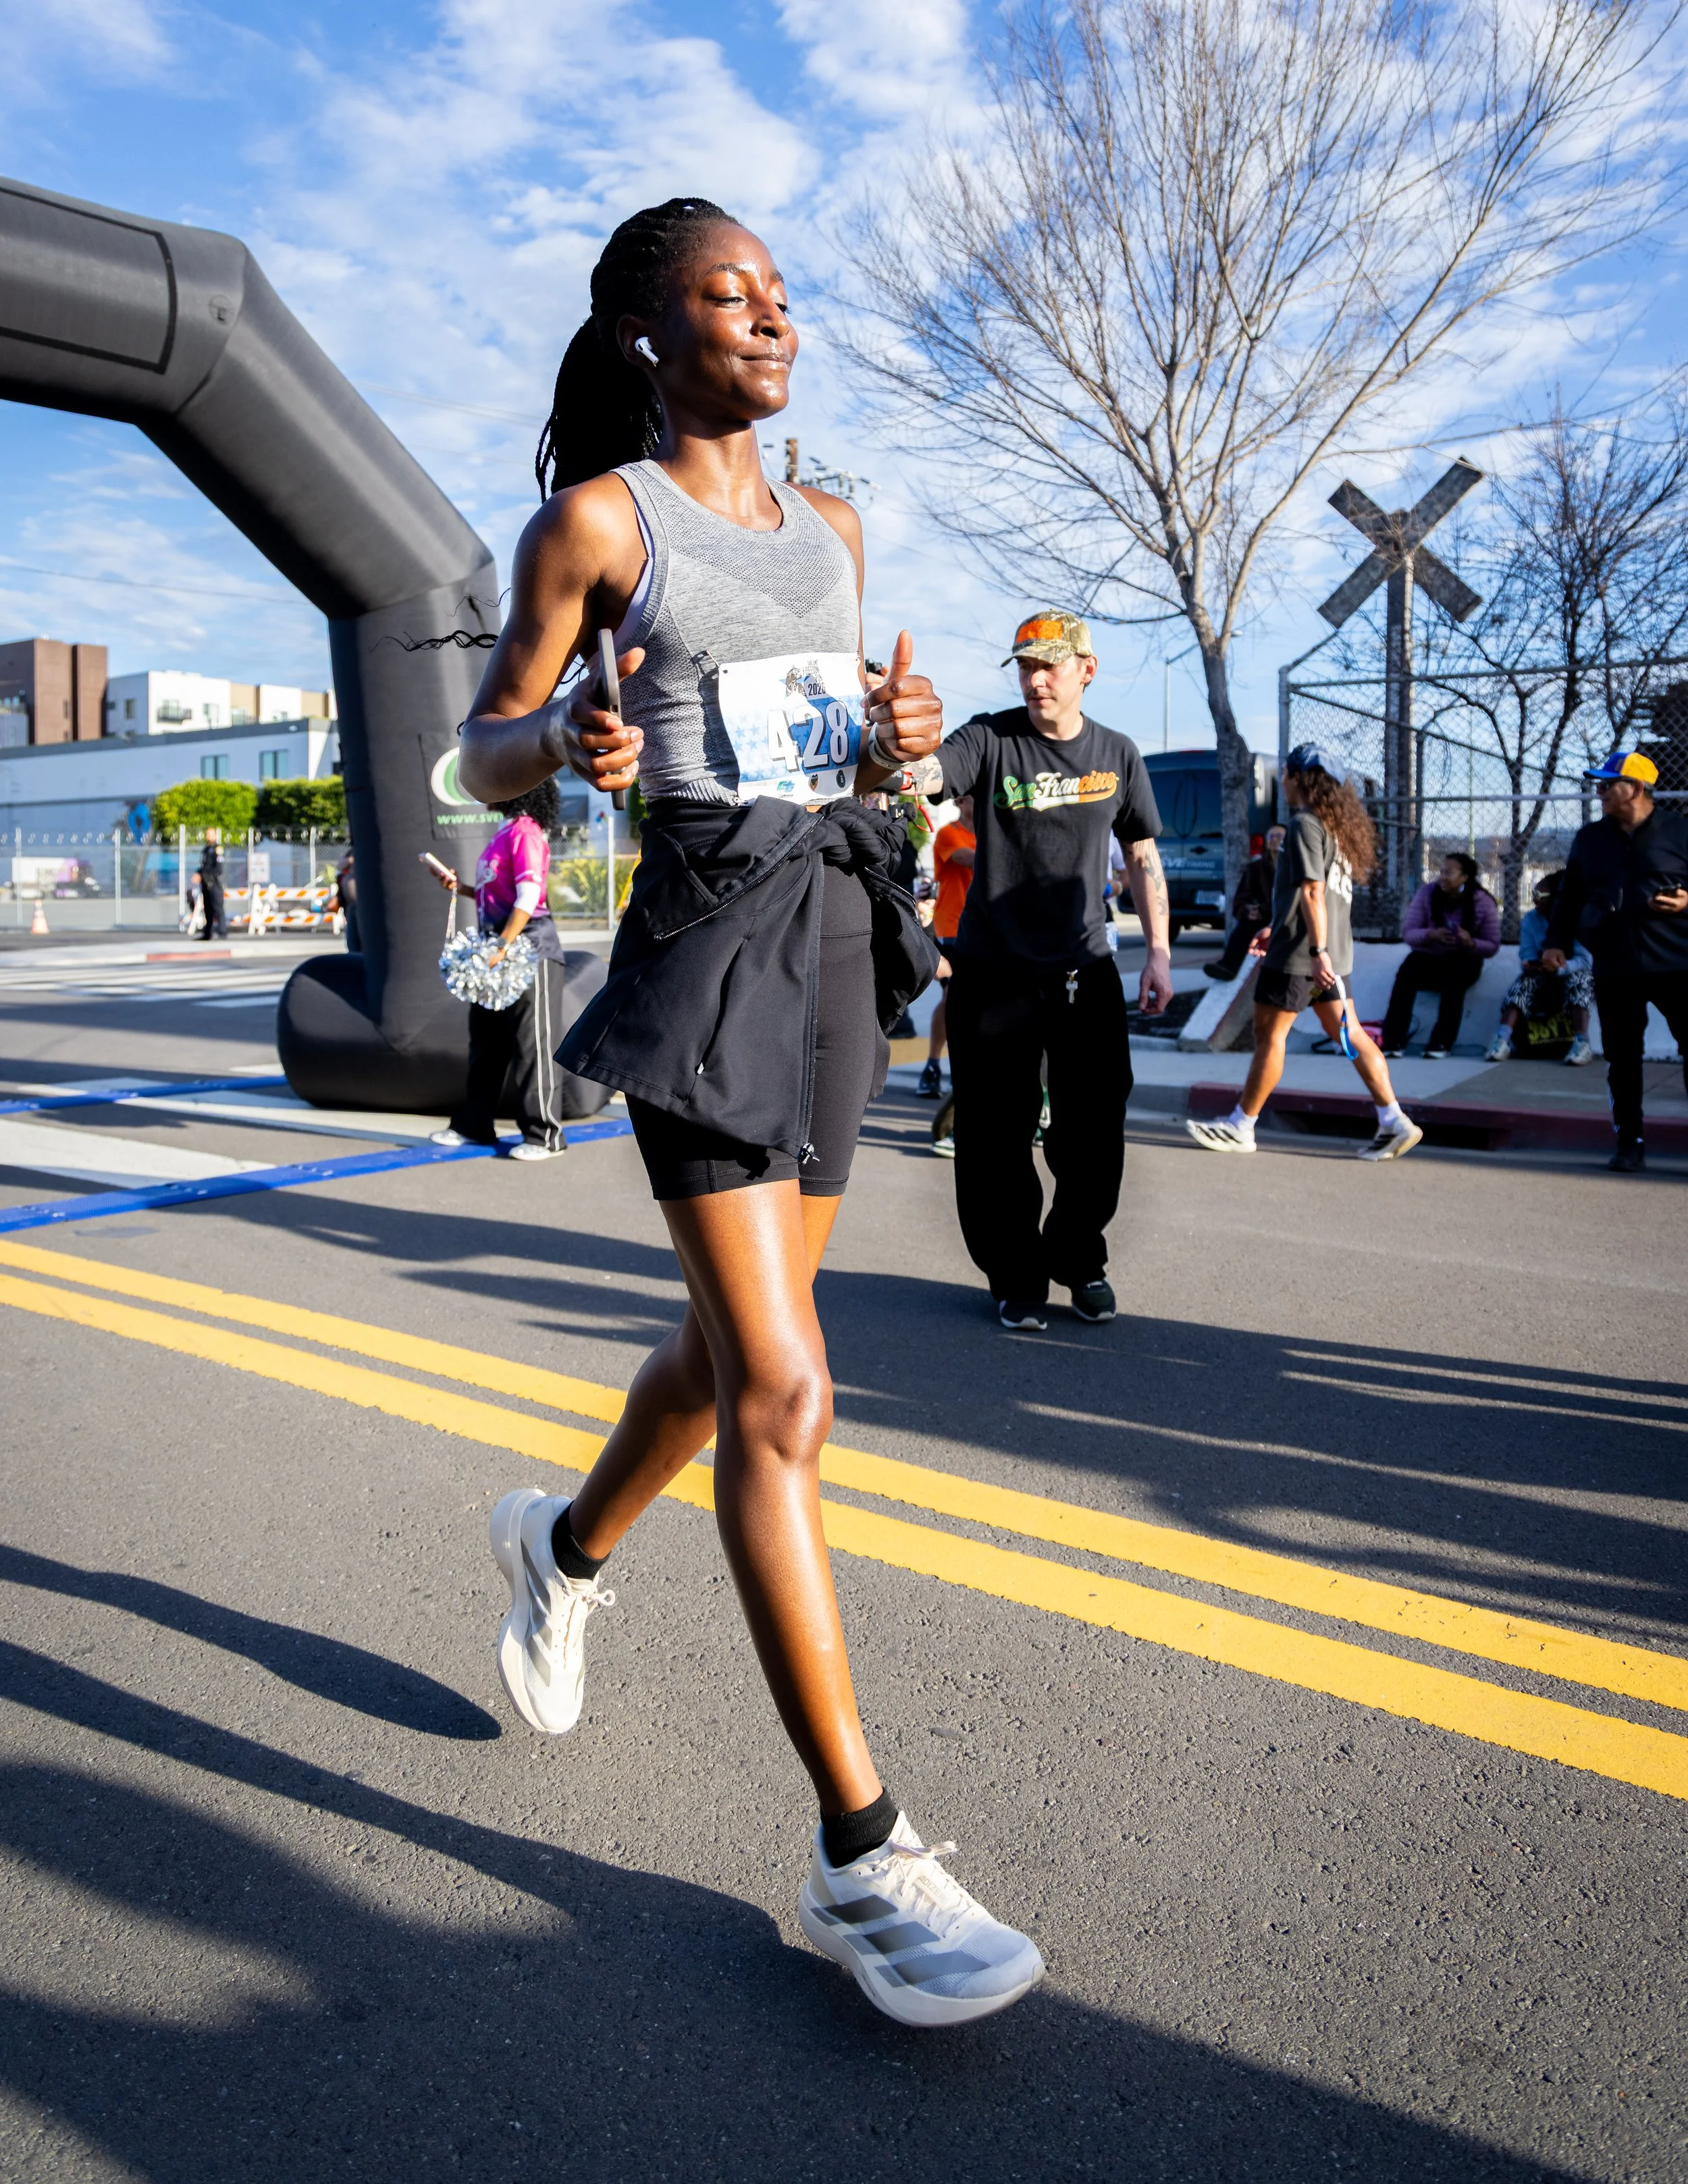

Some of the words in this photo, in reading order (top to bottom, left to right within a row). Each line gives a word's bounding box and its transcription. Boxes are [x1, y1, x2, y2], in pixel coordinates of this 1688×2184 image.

[808, 682, 826, 696] 2026
[767, 701, 849, 772] 428
[994, 776, 1037, 808] San
[1034, 770, 1118, 799] Francisco
